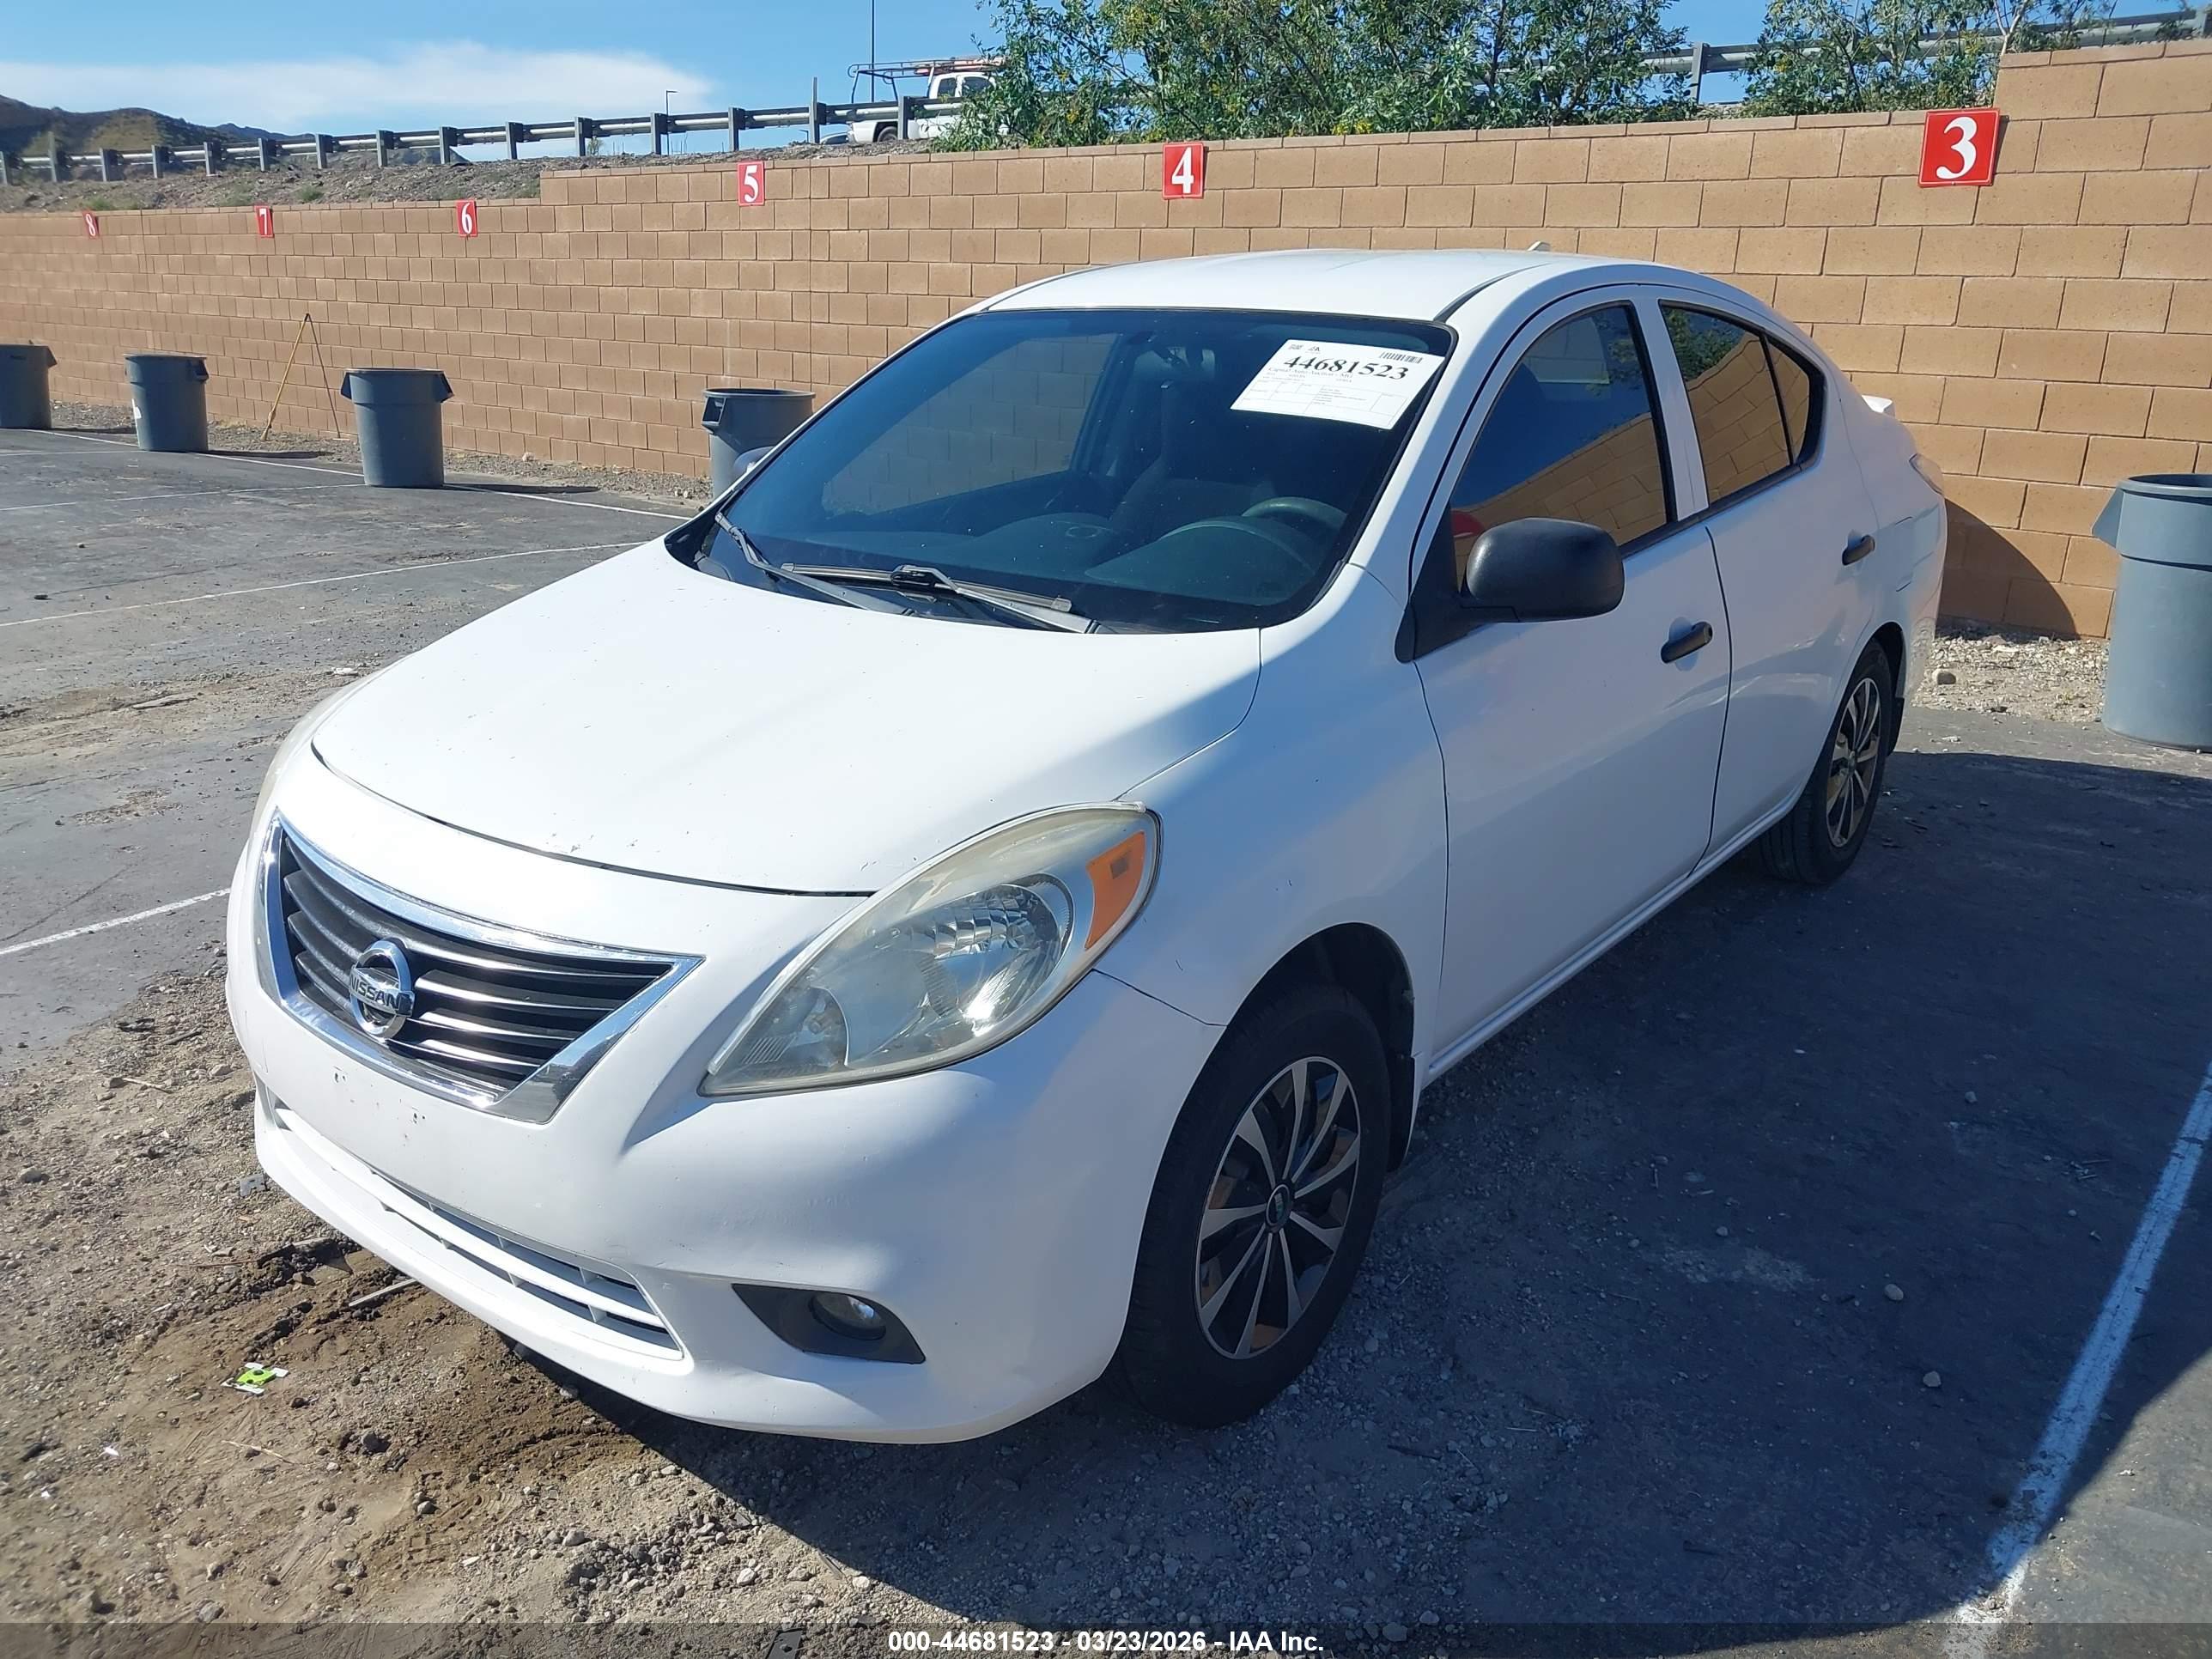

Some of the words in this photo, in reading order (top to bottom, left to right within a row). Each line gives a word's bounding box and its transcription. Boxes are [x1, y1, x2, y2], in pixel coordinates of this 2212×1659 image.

[1936, 116, 1977, 179] 3
[744, 164, 759, 203] 5
[1171, 146, 1194, 194] 4
[86, 213, 96, 236] 8
[258, 208, 268, 235] 7
[461, 202, 473, 234] 6
[1283, 356, 1409, 380] 44681523
[349, 974, 399, 1011] NISSAN
